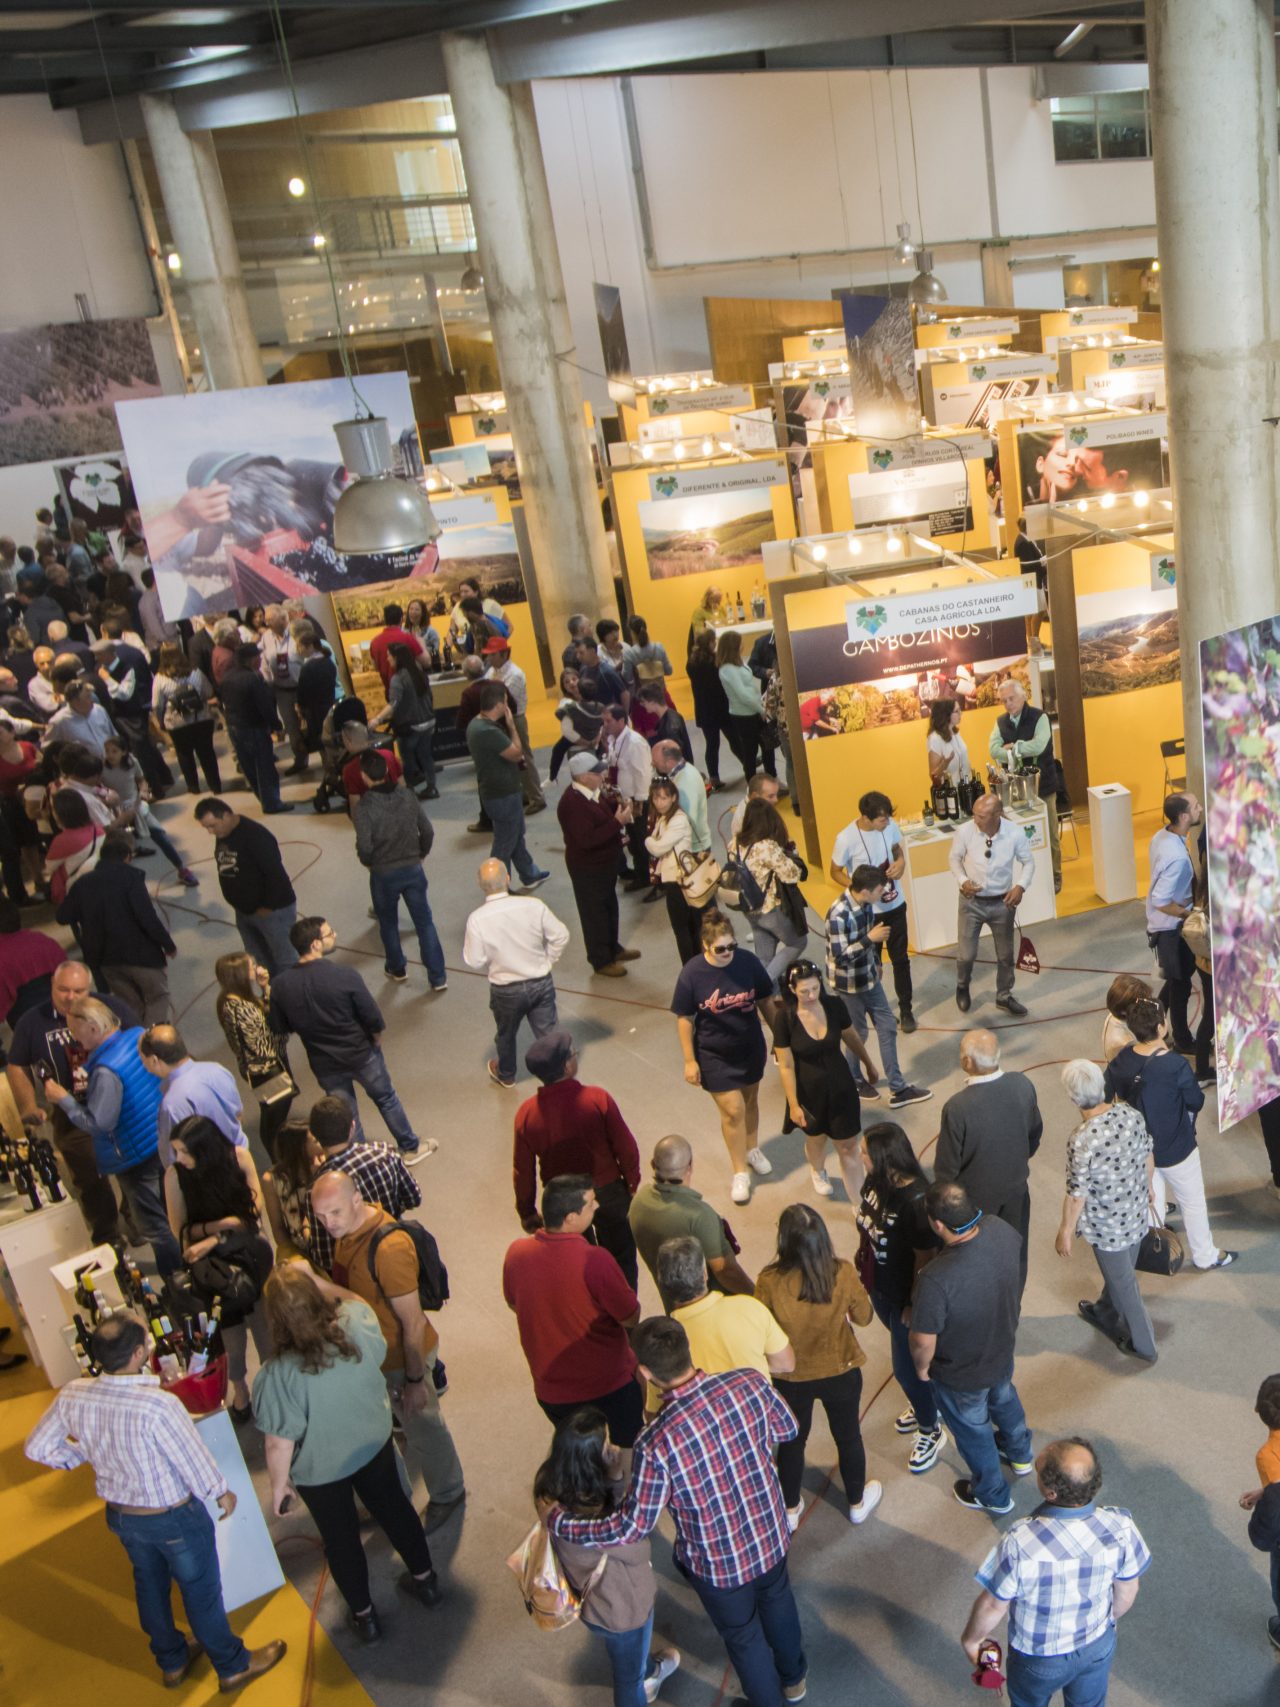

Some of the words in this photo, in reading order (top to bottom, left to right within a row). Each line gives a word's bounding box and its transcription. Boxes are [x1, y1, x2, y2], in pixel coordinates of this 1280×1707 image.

[682, 481, 720, 493] DIFERENTE
[762, 475, 777, 483] LDA
[899, 604, 941, 618] CABANAS
[942, 602, 955, 611] DO
[956, 592, 1015, 609] CASTANHEIRO
[914, 615, 938, 625] CASA
[940, 607, 983, 622] AGRÍCOLA
[984, 605, 1001, 614] LDA
